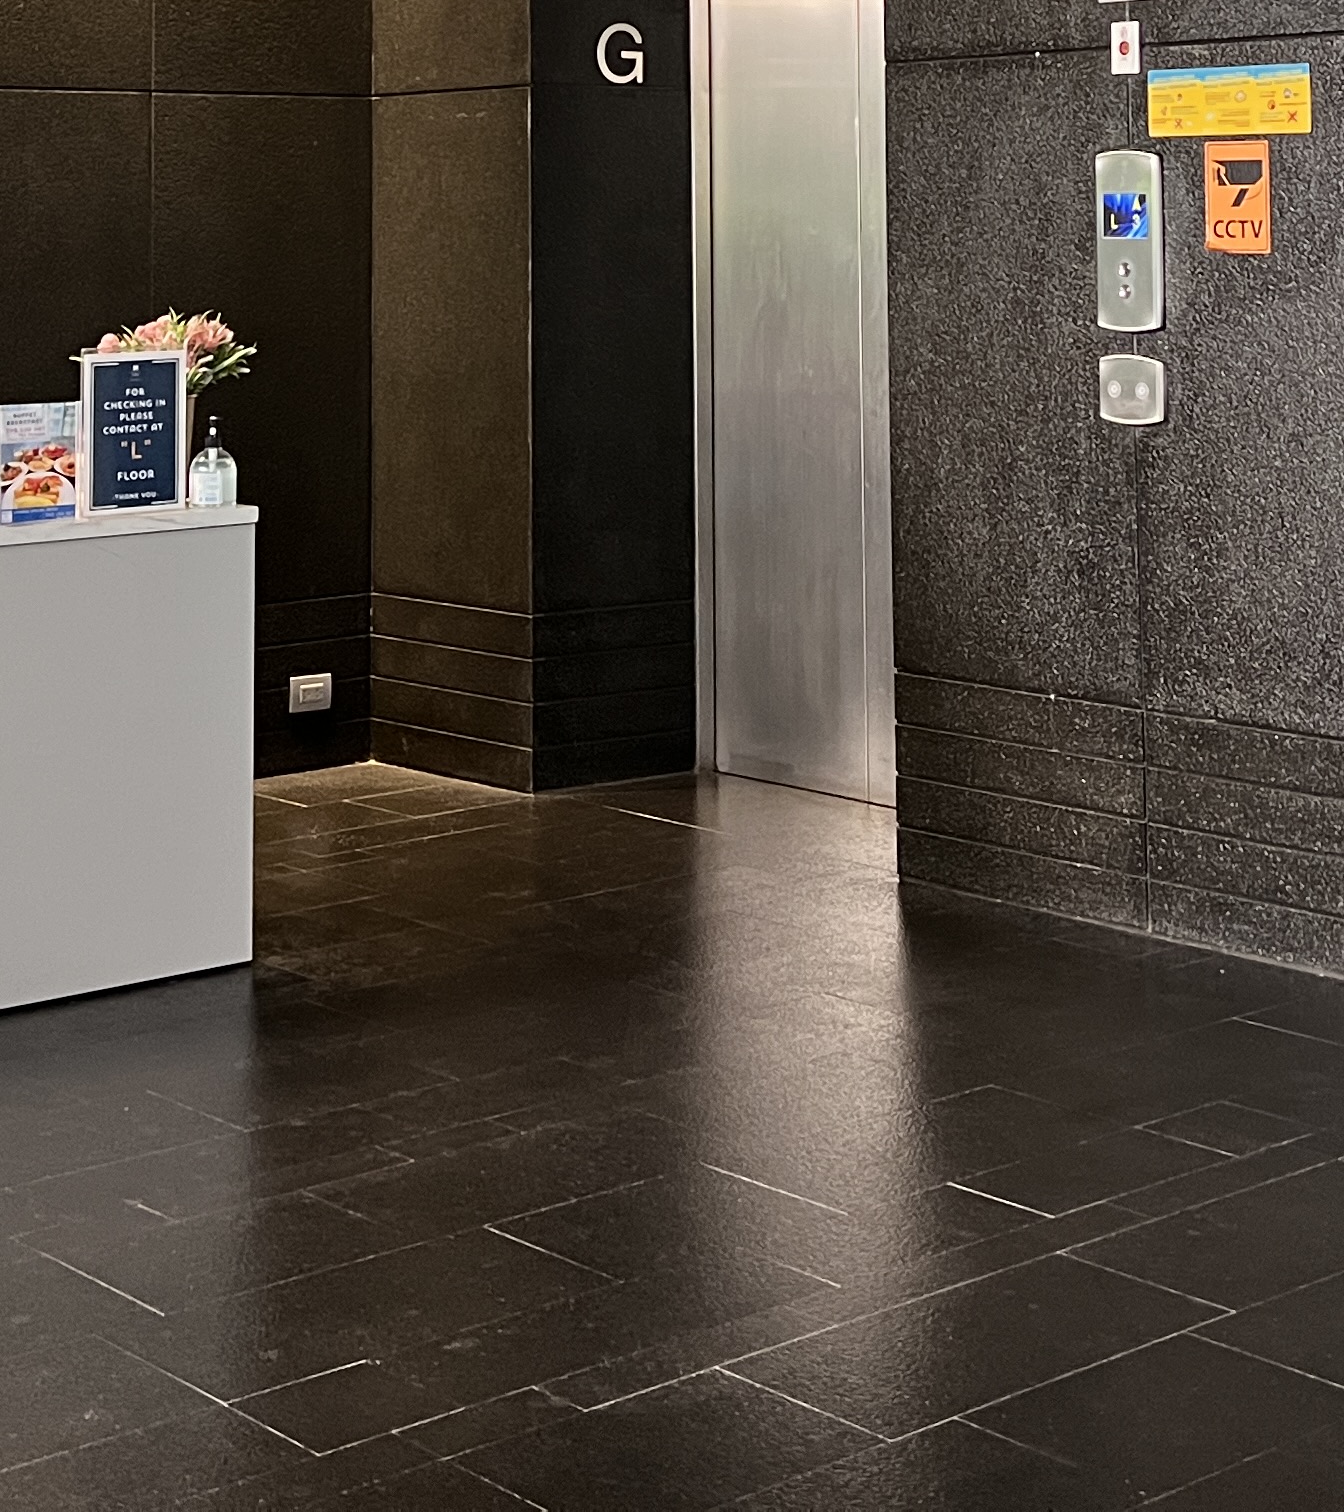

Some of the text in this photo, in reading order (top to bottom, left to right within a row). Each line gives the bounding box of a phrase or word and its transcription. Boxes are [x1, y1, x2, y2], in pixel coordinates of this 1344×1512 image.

[596, 22, 644, 84] G
[1213, 219, 1263, 239] CCTV
[125, 387, 145, 397] FOR
[103, 398, 166, 410] CHECKING IN
[119, 411, 153, 421] PLEASE
[102, 422, 163, 435] CONTACT AT
[116, 469, 155, 481] FLOOR
